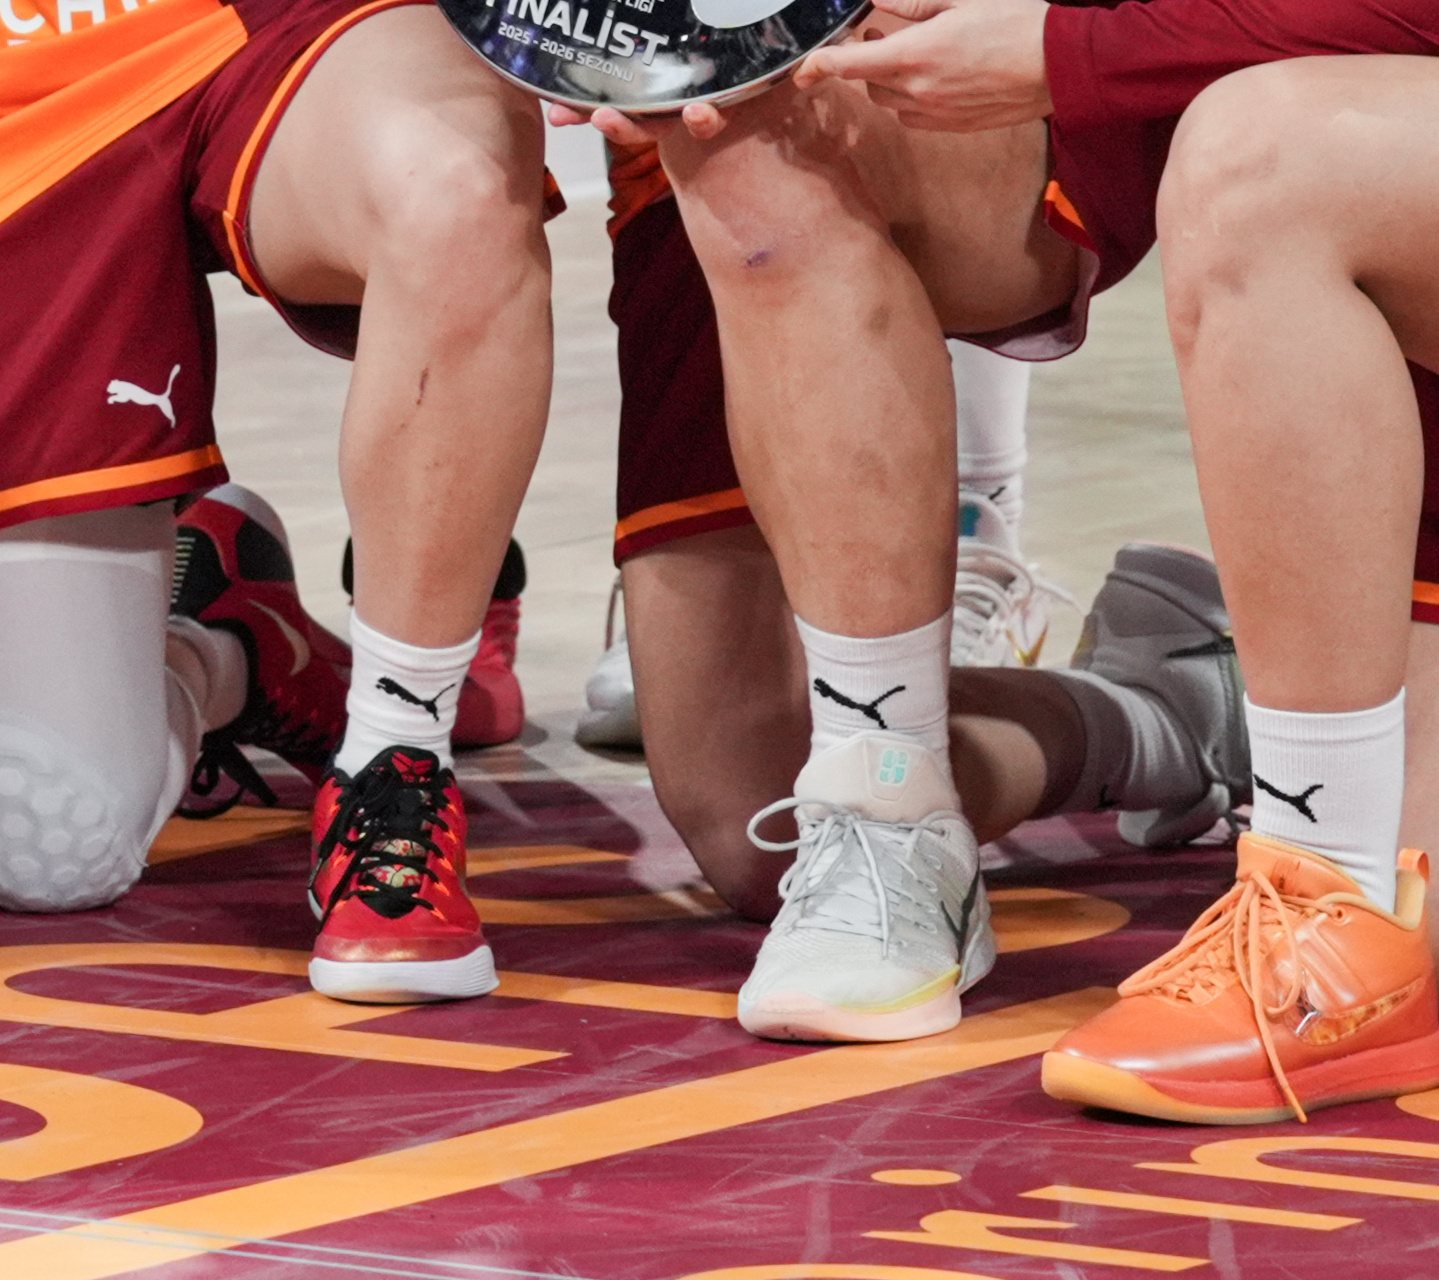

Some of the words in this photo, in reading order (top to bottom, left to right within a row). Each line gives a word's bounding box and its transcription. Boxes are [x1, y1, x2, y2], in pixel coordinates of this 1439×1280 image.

[498, 22, 531, 46] 2025
[540, 37, 574, 62] 2026
[576, 51, 634, 83] SEZONU
